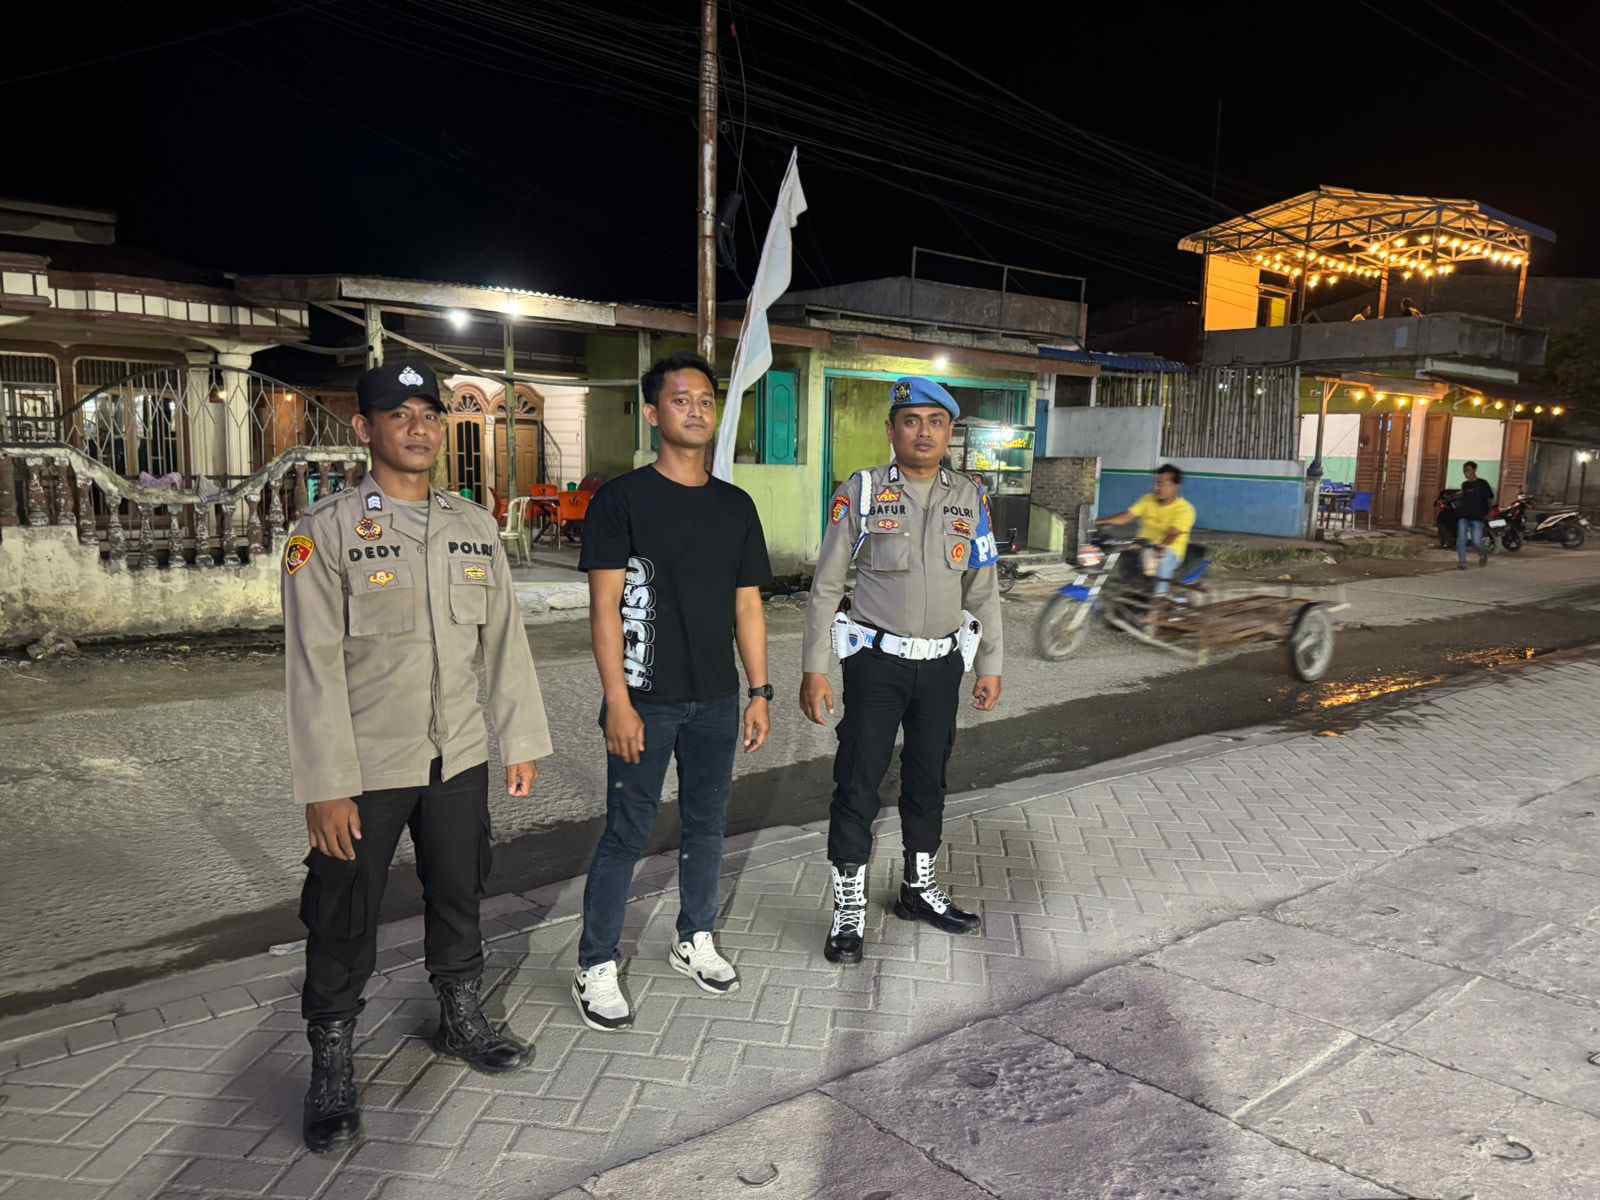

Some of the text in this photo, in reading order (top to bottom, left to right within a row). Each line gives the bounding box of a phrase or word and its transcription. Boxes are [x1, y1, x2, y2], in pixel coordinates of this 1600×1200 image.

[869, 504, 906, 516] GAFUR
[943, 506, 974, 519] POLRI
[348, 544, 401, 562] DEDY
[447, 541, 493, 557] POLRI
